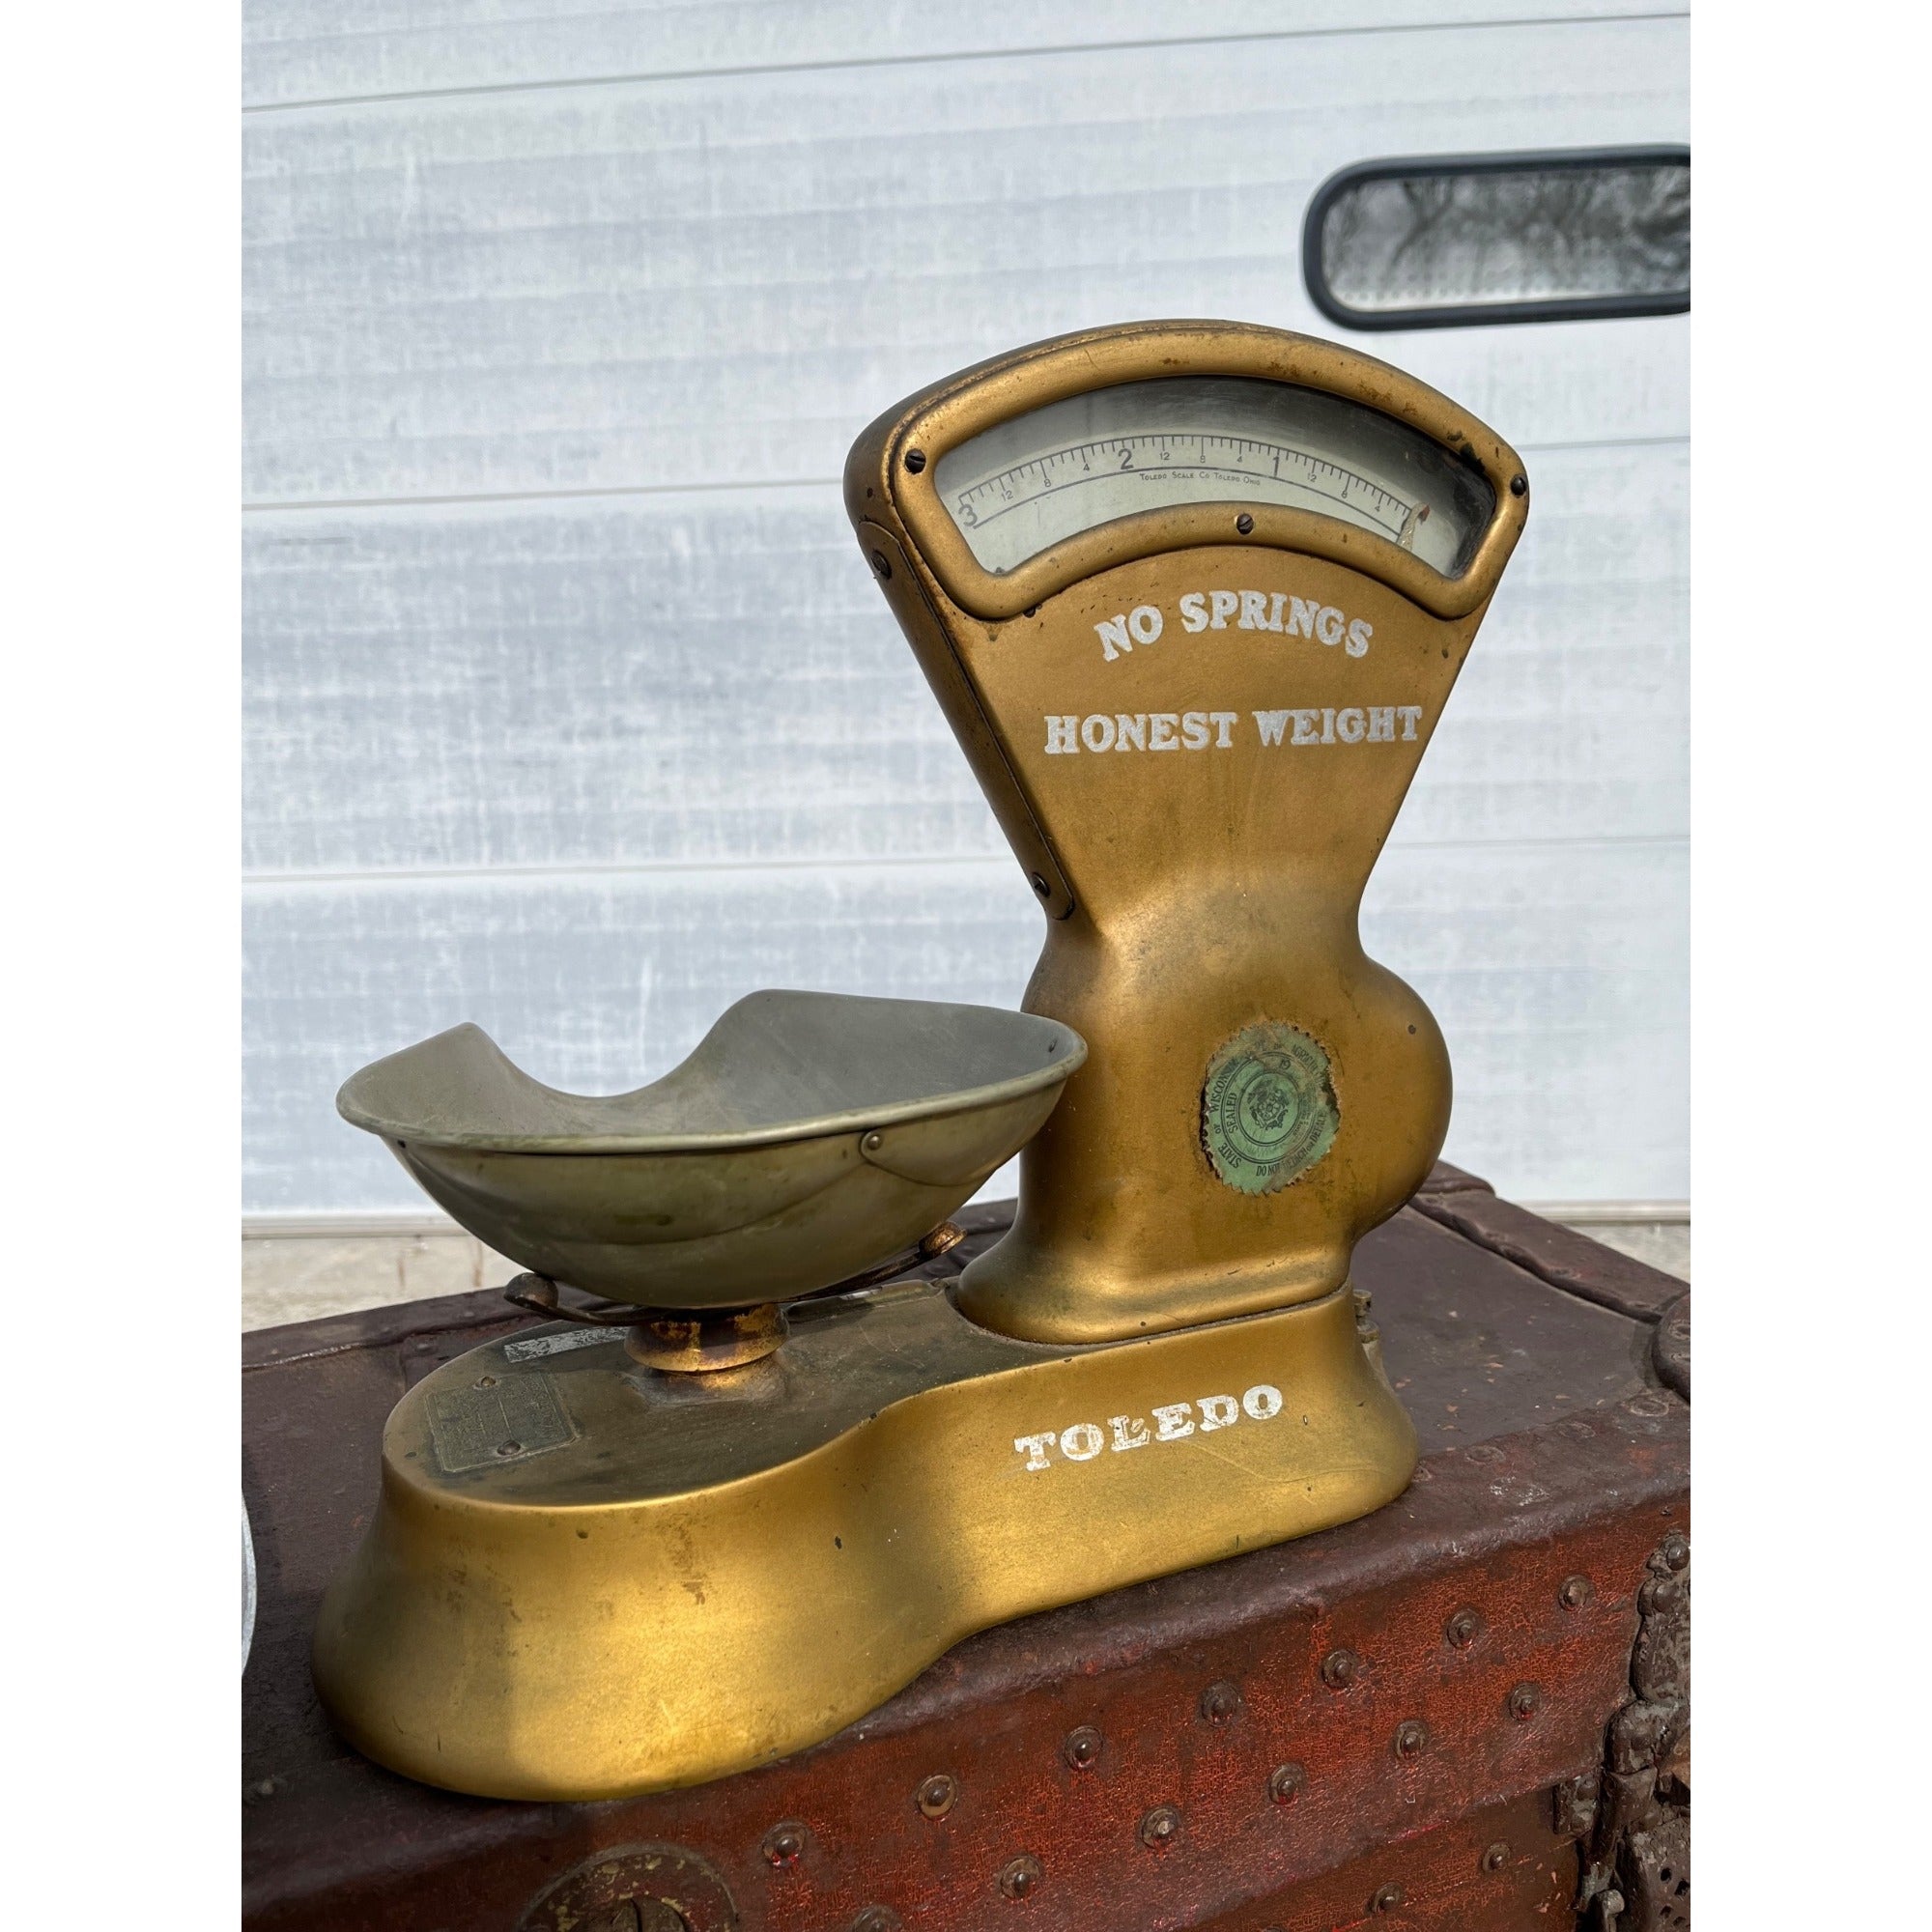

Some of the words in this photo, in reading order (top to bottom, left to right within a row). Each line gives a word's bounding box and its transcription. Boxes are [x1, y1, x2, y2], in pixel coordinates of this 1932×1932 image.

[957, 502, 978, 527] 3
[1001, 490, 1014, 502] 12
[1043, 477, 1052, 488] 8
[1082, 463, 1091, 472] 4
[1117, 448, 1134, 470] 2
[1159, 451, 1171, 461] 12
[1272, 456, 1280, 479] 1
[1307, 472, 1318, 483] 12
[1094, 606, 1163, 662] NO
[1179, 590, 1373, 658] SPRINGS
[1044, 712, 1238, 754] HONEST
[1252, 705, 1423, 747] WEIGHT
[1226, 1093, 1238, 1134] SEALED
[1218, 1143, 1242, 1169] STATE
[1256, 1165, 1267, 1177] DO
[1014, 1385, 1283, 1471] TOLEDO
